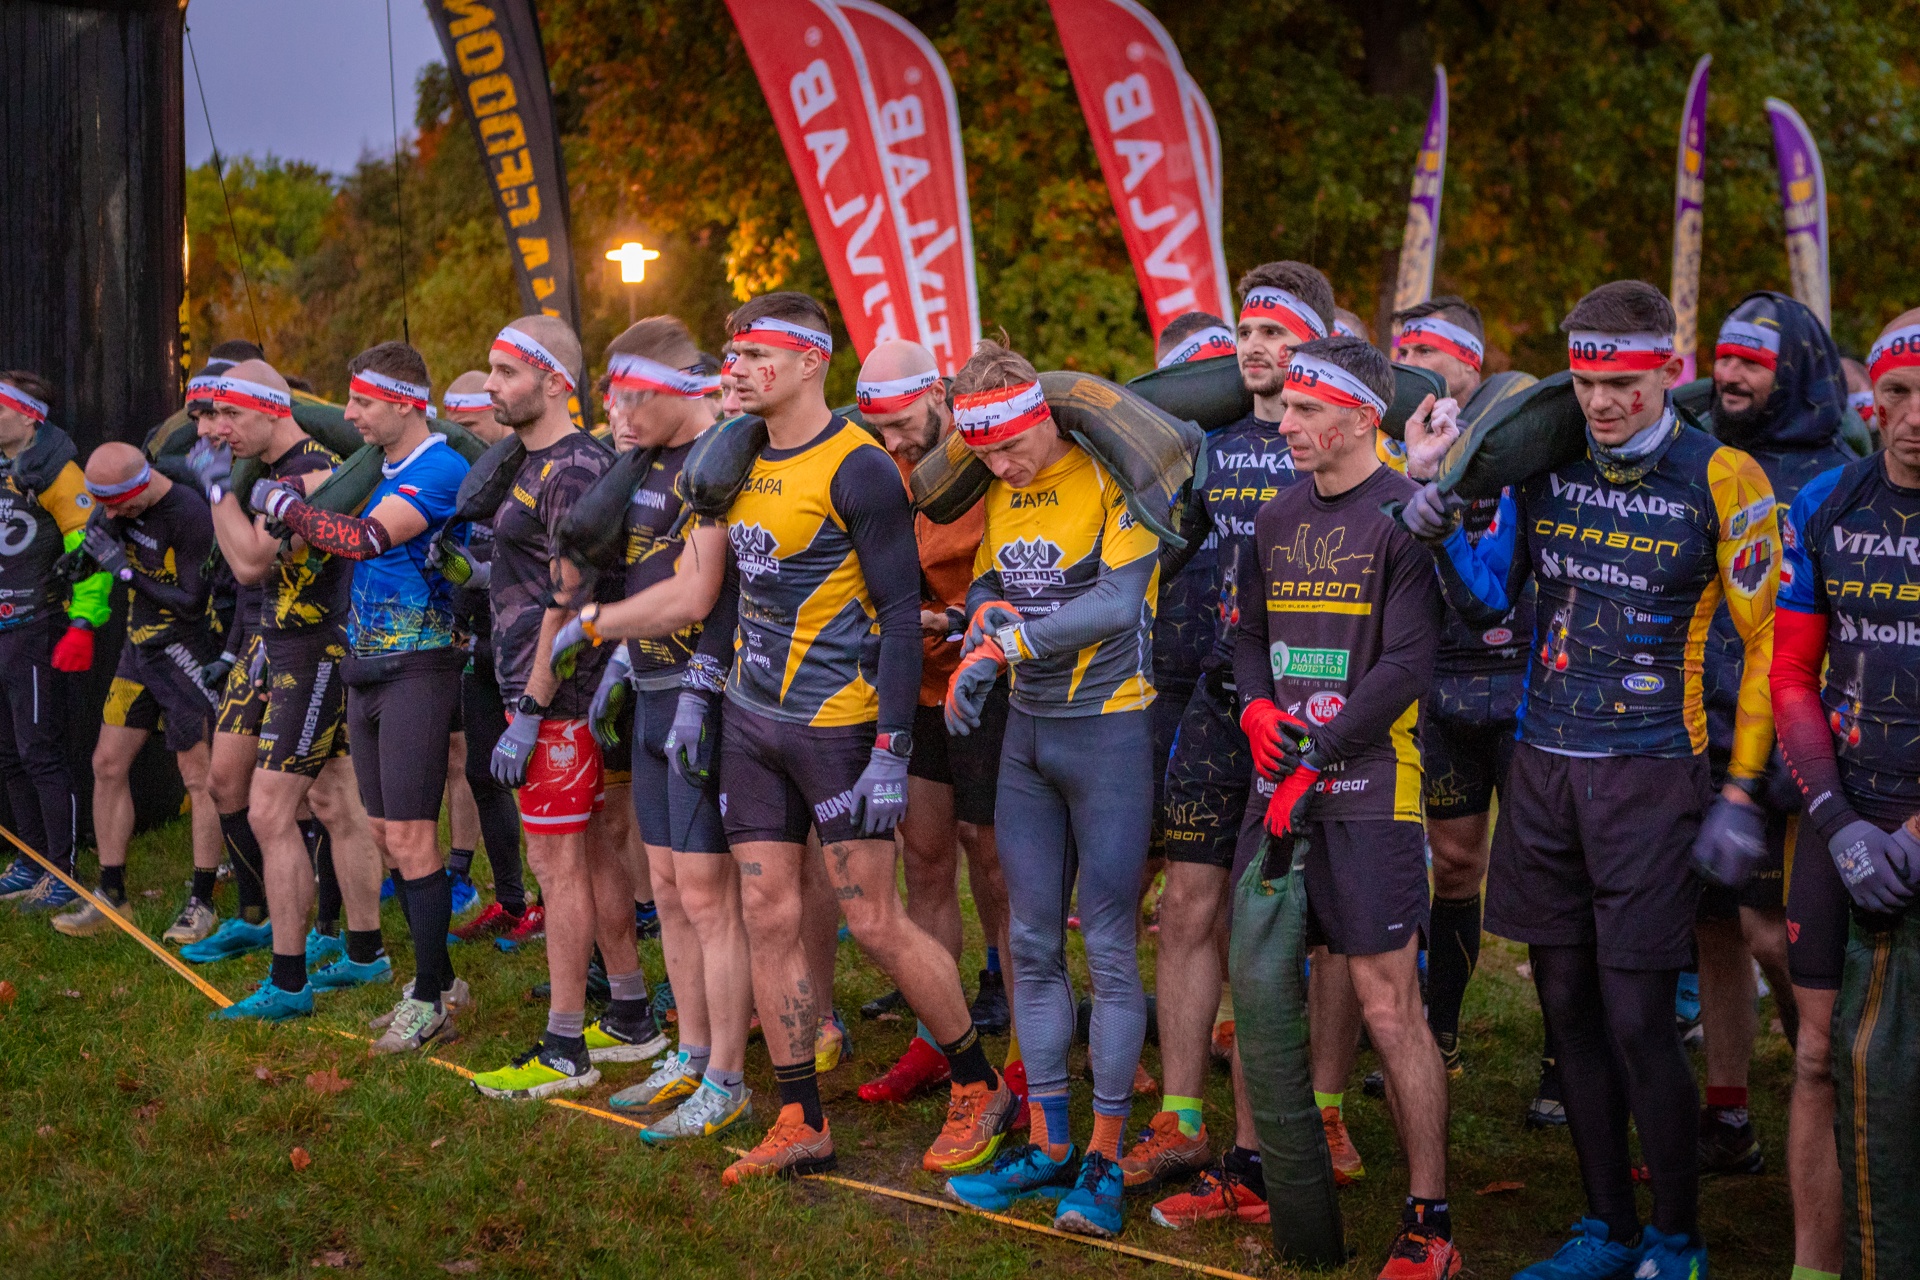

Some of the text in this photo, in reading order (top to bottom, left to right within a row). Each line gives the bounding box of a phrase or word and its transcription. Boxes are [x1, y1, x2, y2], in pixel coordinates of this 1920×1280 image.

[1209, 334, 1235, 348] 00
[1572, 340, 1618, 362] 002
[1319, 368, 1334, 380] ELITE
[1216, 449, 1296, 474] VITARA
[1208, 488, 1278, 502] CARB
[1550, 472, 1686, 518] VITARADE
[317, 520, 361, 546] RACE
[1535, 520, 1680, 557] CARBON
[1833, 525, 1920, 566] VITAR
[1002, 569, 1066, 586] SOCIOS
[1272, 581, 1361, 599] CARBON
[1826, 579, 1920, 601] CARB
[1290, 663, 1342, 675] PROTETION
[1292, 652, 1344, 666] NATRE'S
[295, 661, 333, 757] RUNMAGEDDON
[1164, 829, 1205, 842] RBON
